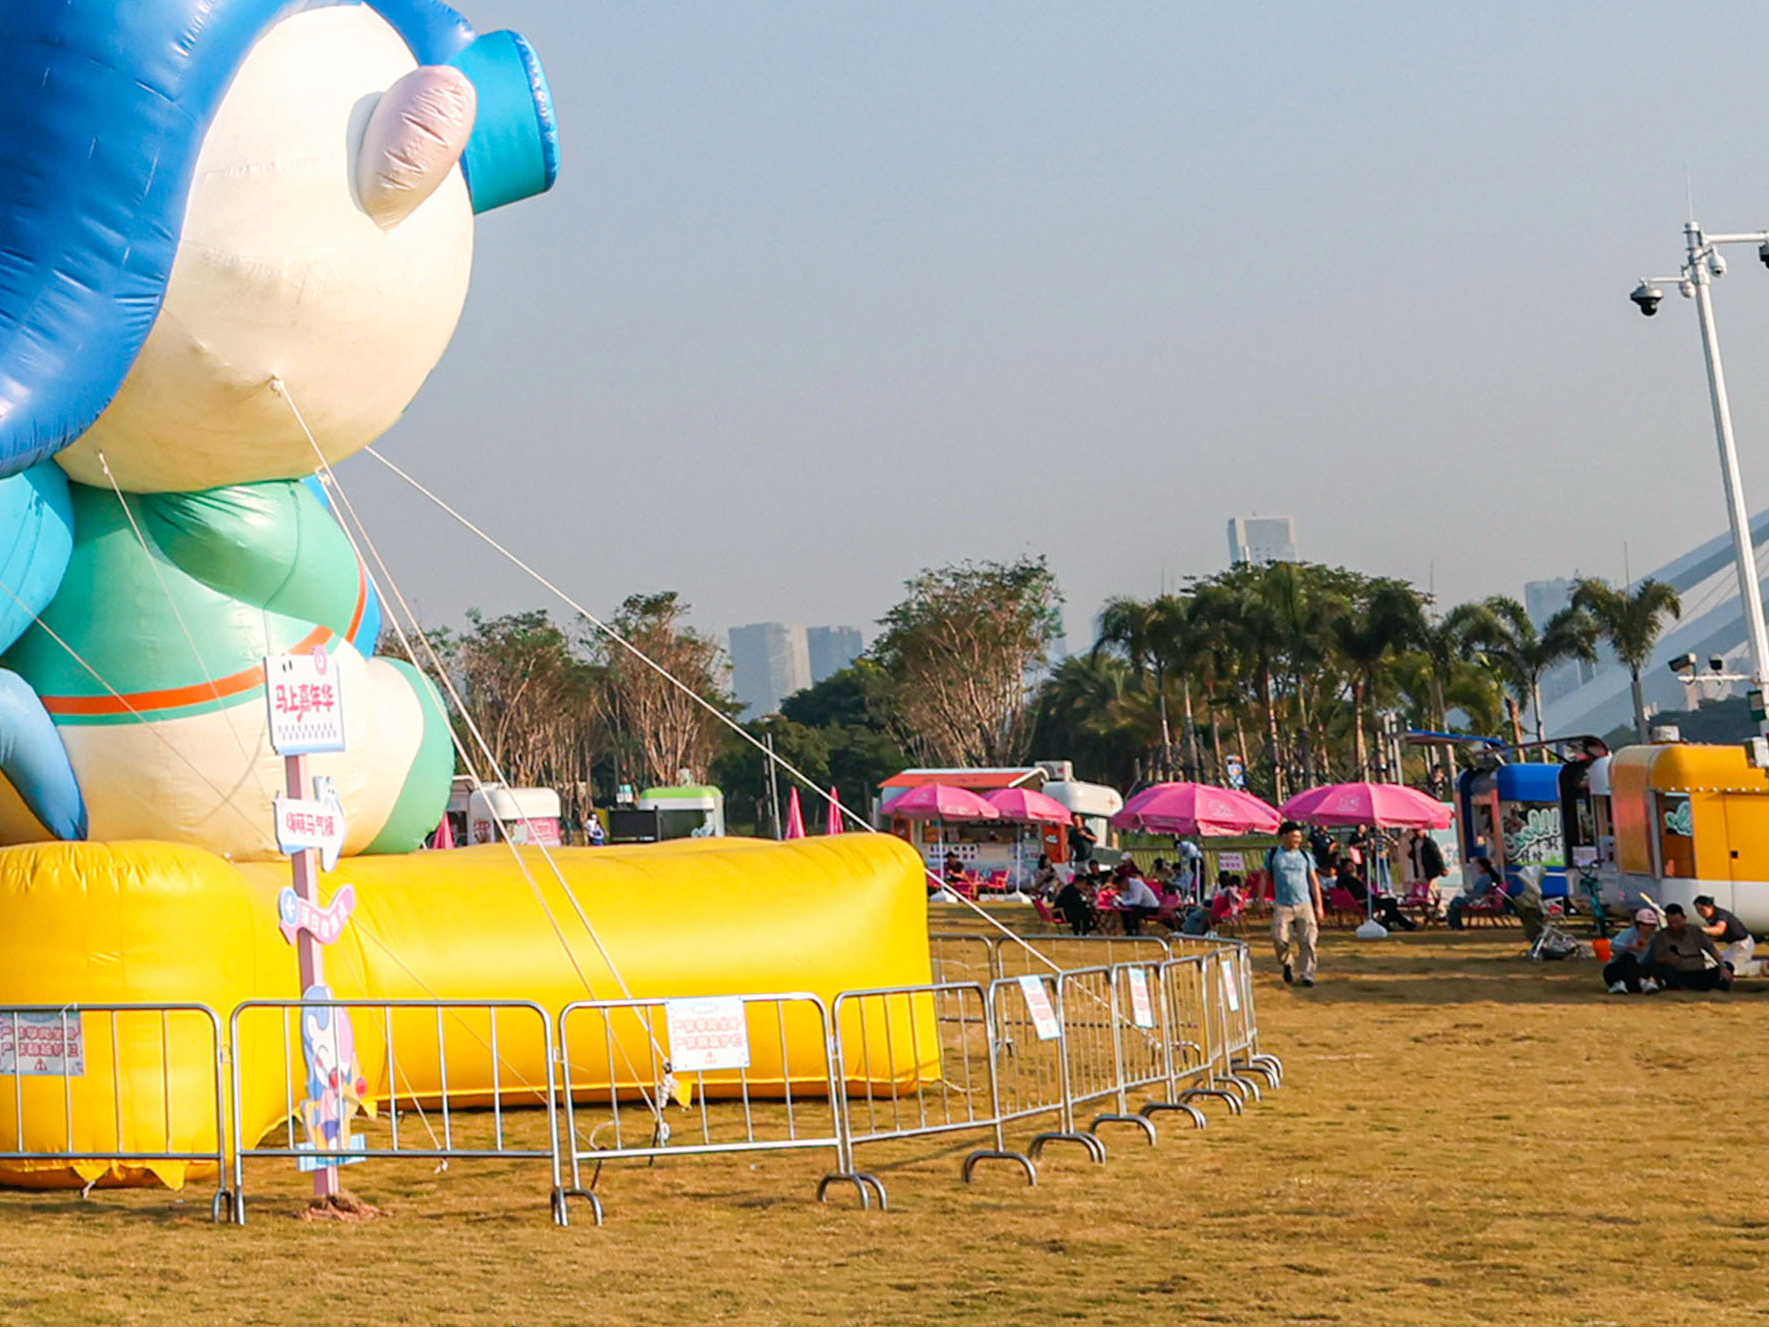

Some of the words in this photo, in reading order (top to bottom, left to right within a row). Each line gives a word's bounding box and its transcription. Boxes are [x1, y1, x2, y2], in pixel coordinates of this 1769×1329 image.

[275, 682, 335, 723] 马上嘉年华
